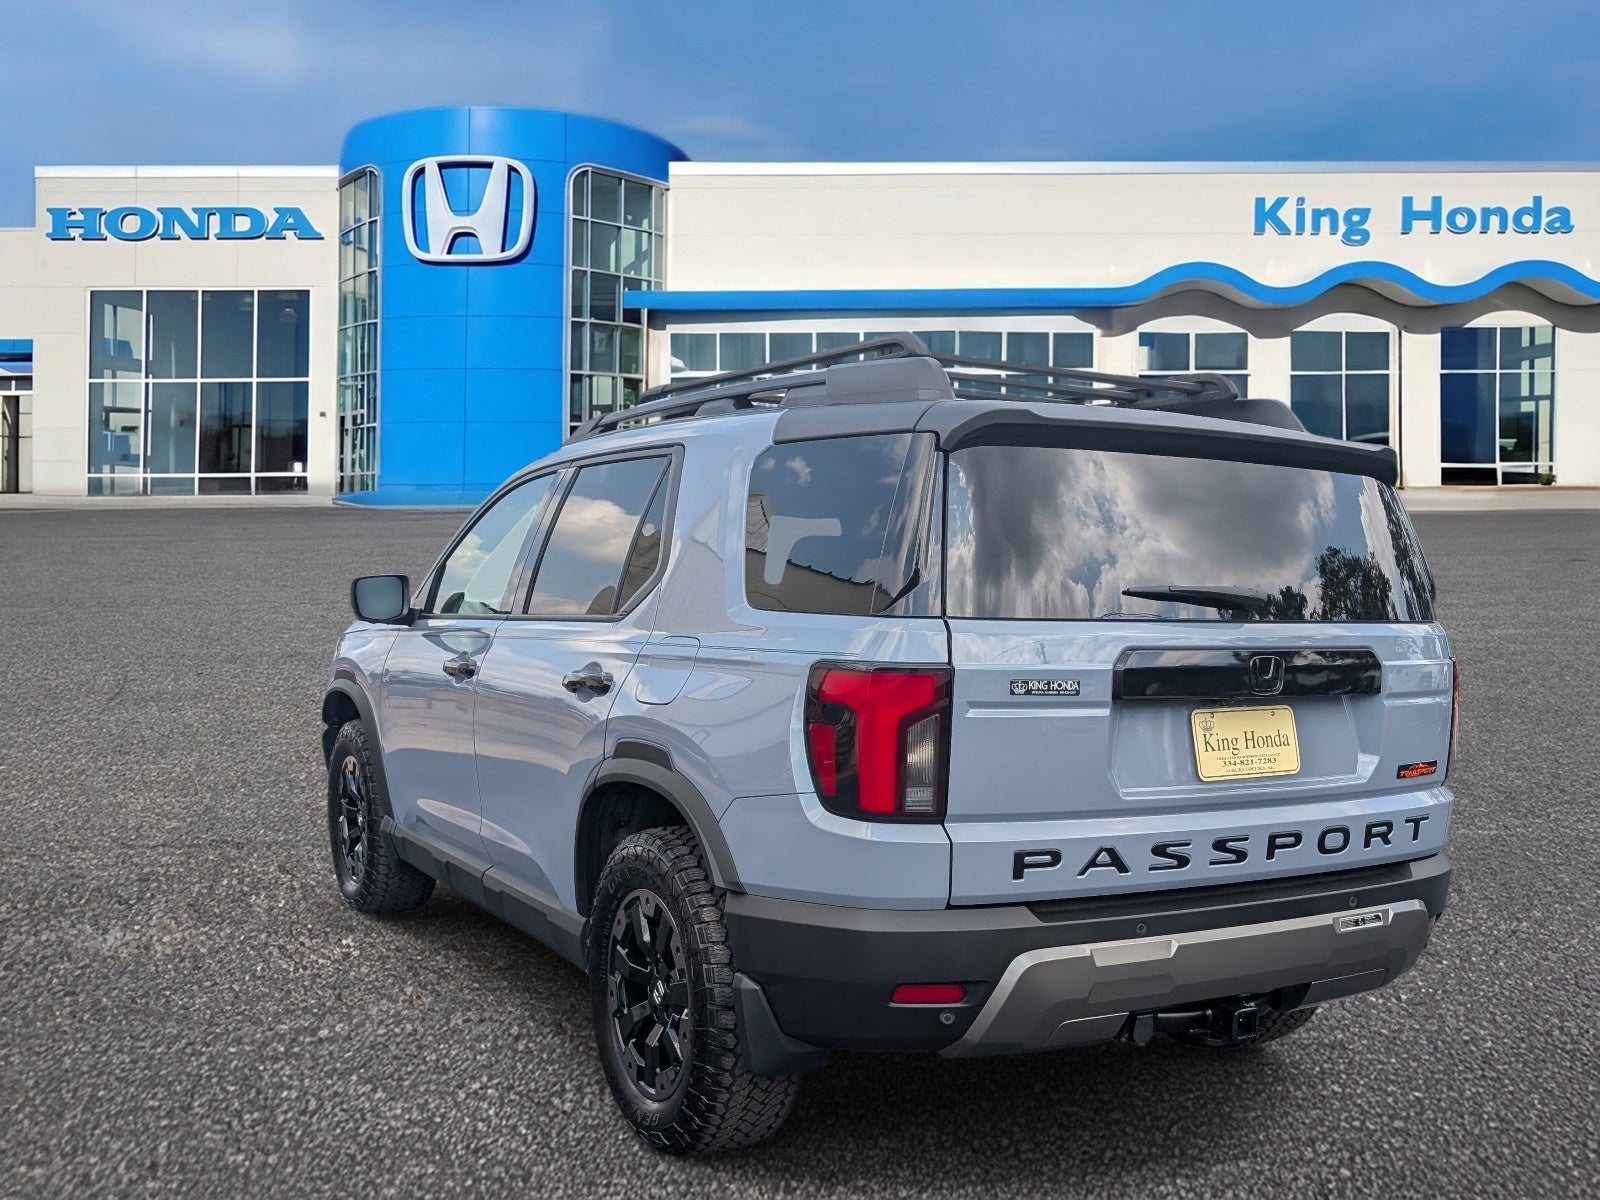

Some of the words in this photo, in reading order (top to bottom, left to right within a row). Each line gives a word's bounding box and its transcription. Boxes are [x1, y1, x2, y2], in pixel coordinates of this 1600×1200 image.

[45, 205, 325, 242] HONDA
[1252, 196, 1372, 246] King
[1401, 195, 1575, 235] Honda
[1028, 681, 1048, 690] KING
[1050, 681, 1079, 690] HONDA
[1203, 732, 1240, 755] King
[1243, 729, 1290, 749] Honda
[1222, 758, 1277, 767] 334-821-7283
[1011, 813, 1431, 883] PASSPORT
